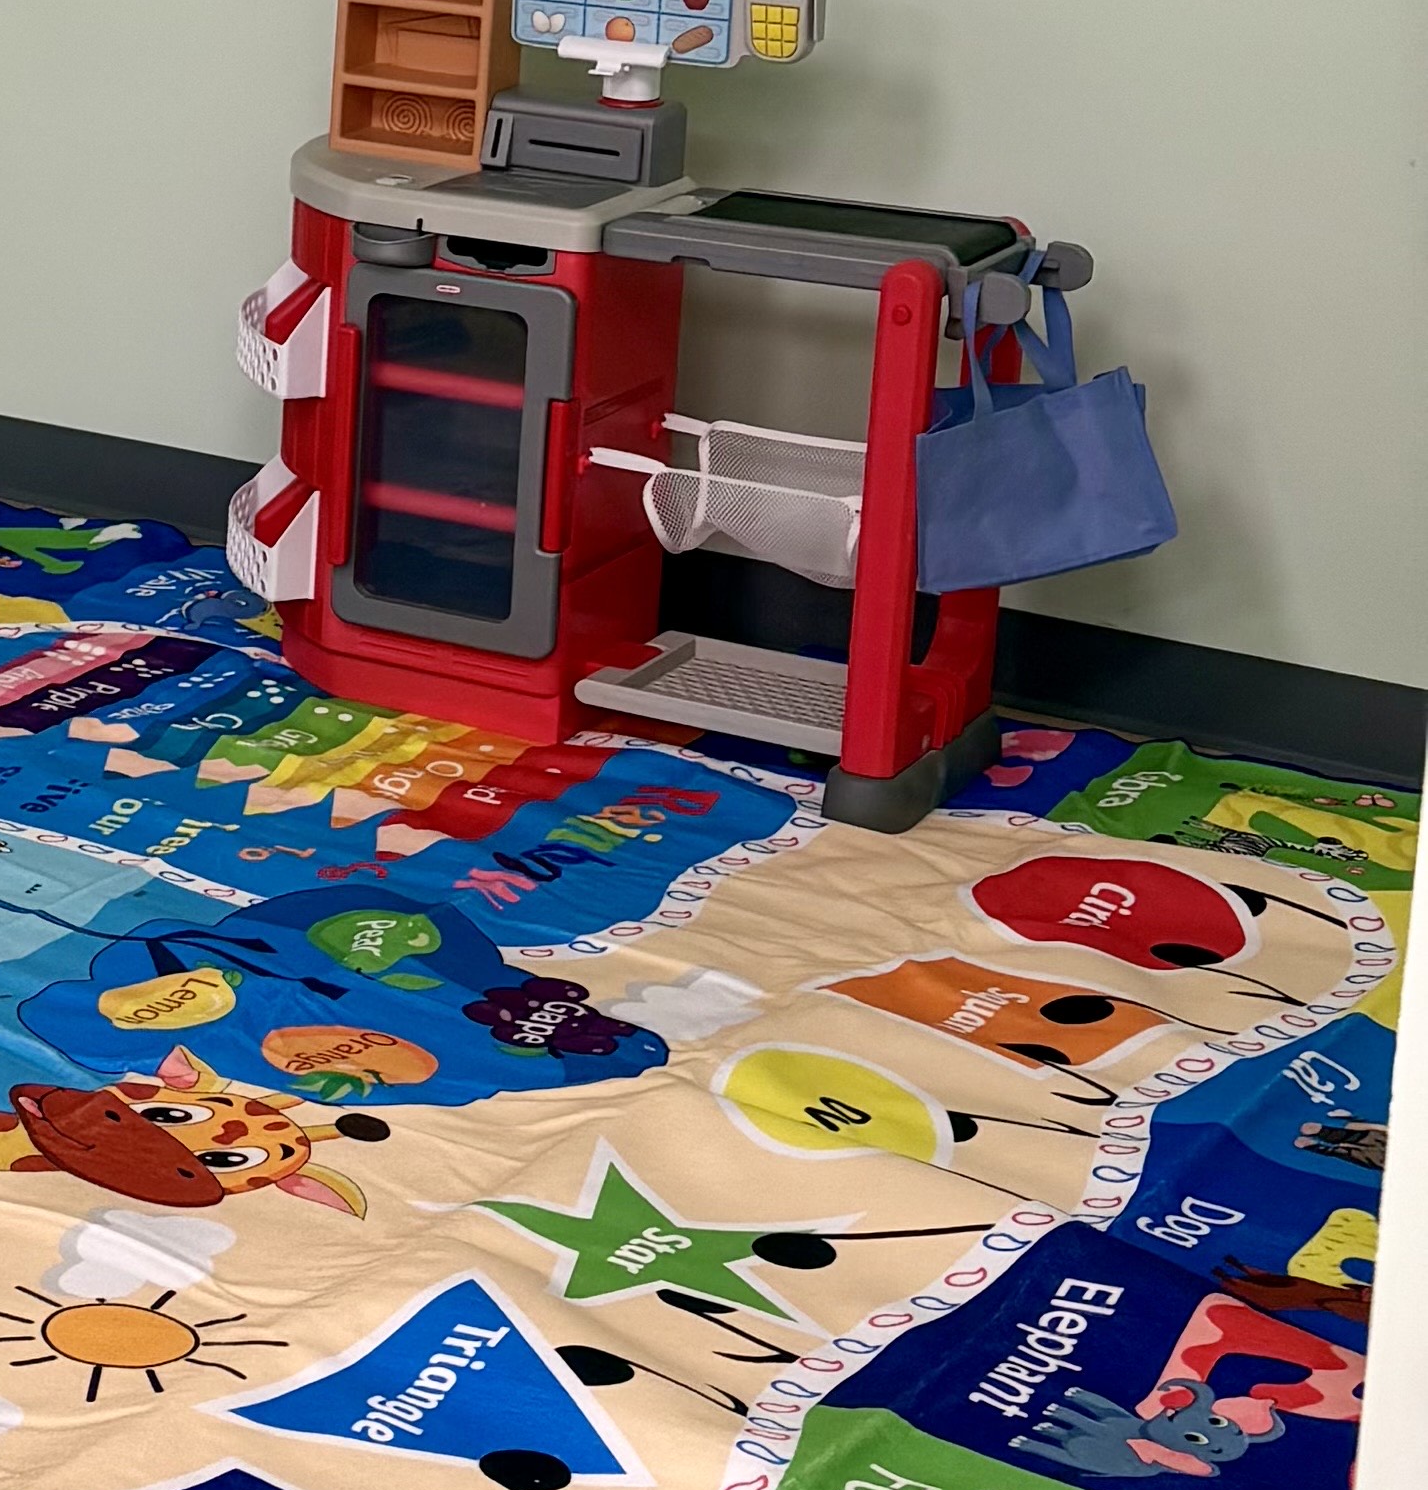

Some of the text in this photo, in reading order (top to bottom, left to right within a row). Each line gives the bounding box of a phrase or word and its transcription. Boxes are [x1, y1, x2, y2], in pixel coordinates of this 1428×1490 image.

[88, 796, 164, 837] our
[351, 919, 396, 958] Pear
[114, 975, 219, 1027] Lemon
[283, 1031, 398, 1072] Orange
[1135, 1195, 1246, 1250] Dog
[606, 1227, 692, 1275] Star
[969, 1277, 1125, 1419] Elephant
[350, 1320, 511, 1444] Triangle
